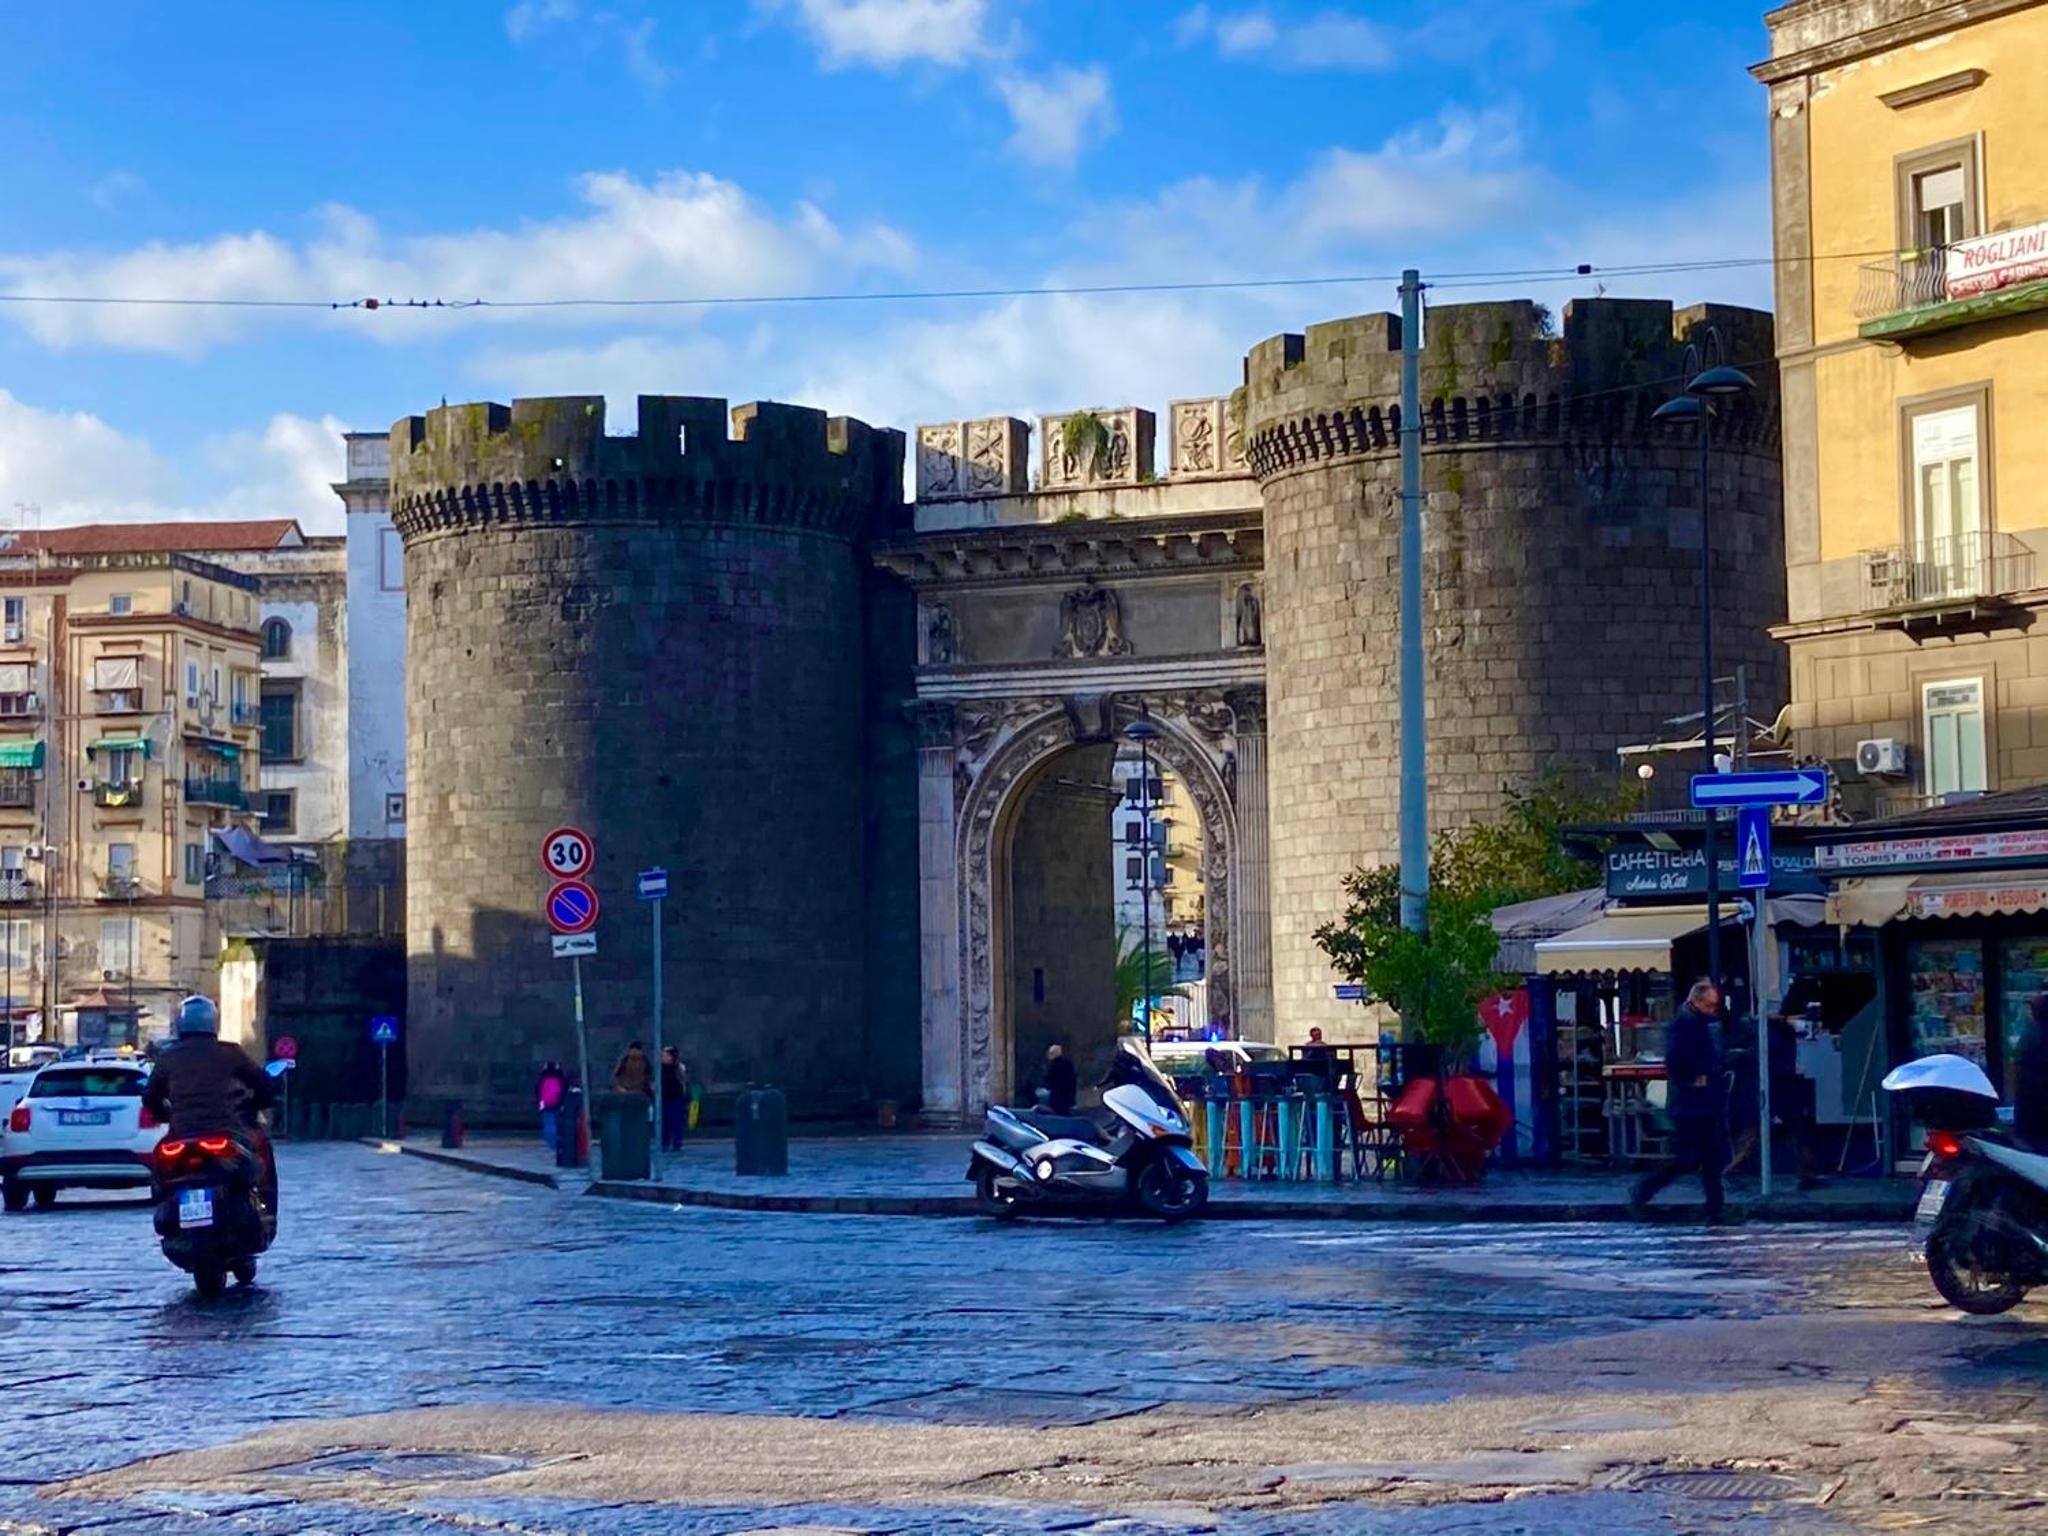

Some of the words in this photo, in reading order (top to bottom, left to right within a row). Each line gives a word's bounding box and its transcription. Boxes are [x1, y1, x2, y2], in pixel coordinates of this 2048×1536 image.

[552, 842, 583, 866] 30
[1844, 842, 1887, 854] TICKET
[1892, 840, 1930, 850] POINT
[1609, 848, 1706, 872] CAFFETTERIA
[1844, 853, 1898, 865] TOURIST
[1905, 851, 1932, 861] BUS
